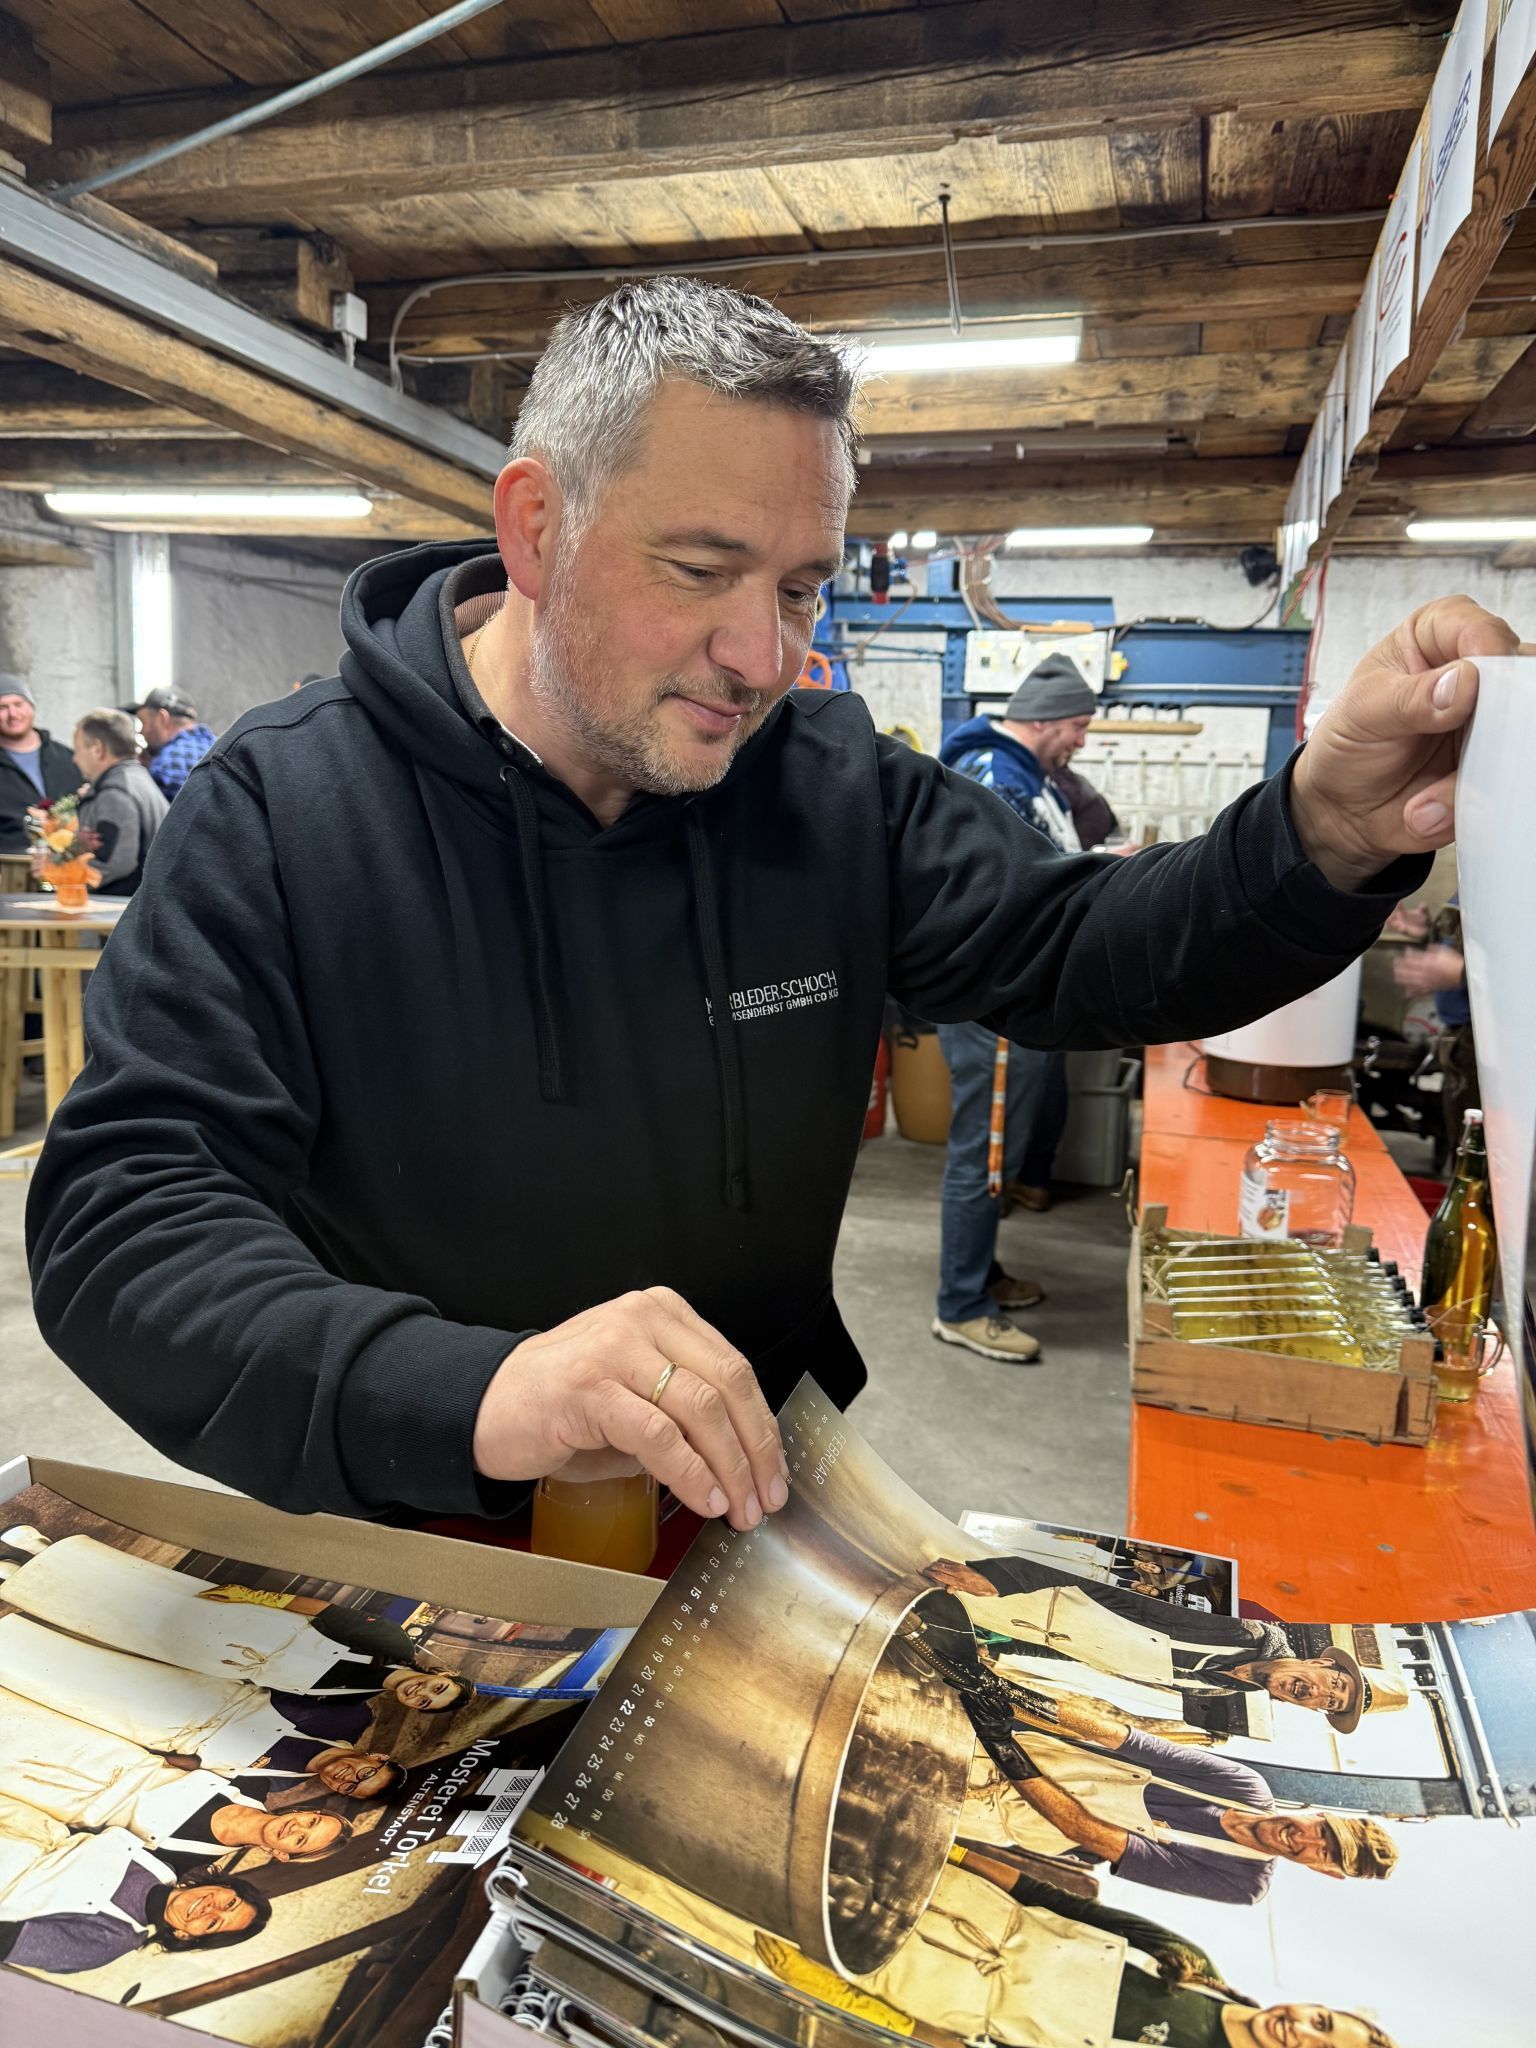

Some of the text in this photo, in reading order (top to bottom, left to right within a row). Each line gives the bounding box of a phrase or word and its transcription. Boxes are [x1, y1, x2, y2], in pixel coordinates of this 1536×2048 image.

[786, 996, 813, 1010] GMBH
[814, 992, 827, 1003] CO
[828, 988, 839, 1000] KG
[810, 1400, 816, 1408] 1
[802, 1410, 810, 1420] 2
[795, 1422, 802, 1431] 3
[811, 1430, 847, 1485] FEBRUAR
[728, 1528, 738, 1538] 11
[719, 1541, 729, 1553] 12
[709, 1556, 720, 1568] 13
[736, 1557, 744, 1568] DO
[700, 1571, 710, 1583] 14
[690, 1586, 702, 1599] 15
[681, 1602, 692, 1614] 16
[709, 1602, 718, 1613] SO
[672, 1619, 683, 1631] 17
[700, 1617, 710, 1629] MO
[661, 1634, 674, 1646] 18
[652, 1650, 664, 1663] 19
[641, 1665, 655, 1680] 20
[673, 1665, 684, 1676] DO
[632, 1683, 645, 1696] 21
[664, 1682, 674, 1693] FR
[619, 1699, 636, 1716] 22
[609, 1717, 625, 1732] 23
[644, 1715, 656, 1727] SO
[598, 1735, 614, 1751] 24
[633, 1733, 646, 1746] MO
[587, 1753, 604, 1771] 25
[624, 1752, 635, 1762] DI
[575, 1772, 592, 1789] 26
[614, 1770, 625, 1781] MI
[564, 1792, 581, 1810] 27
[602, 1788, 615, 1802] DO
[379, 1773, 439, 1845] ALTENSTADT
[590, 1808, 603, 1821] FR
[362, 1738, 500, 1895] Mosterei Torkel
[551, 1812, 569, 1830] 28
